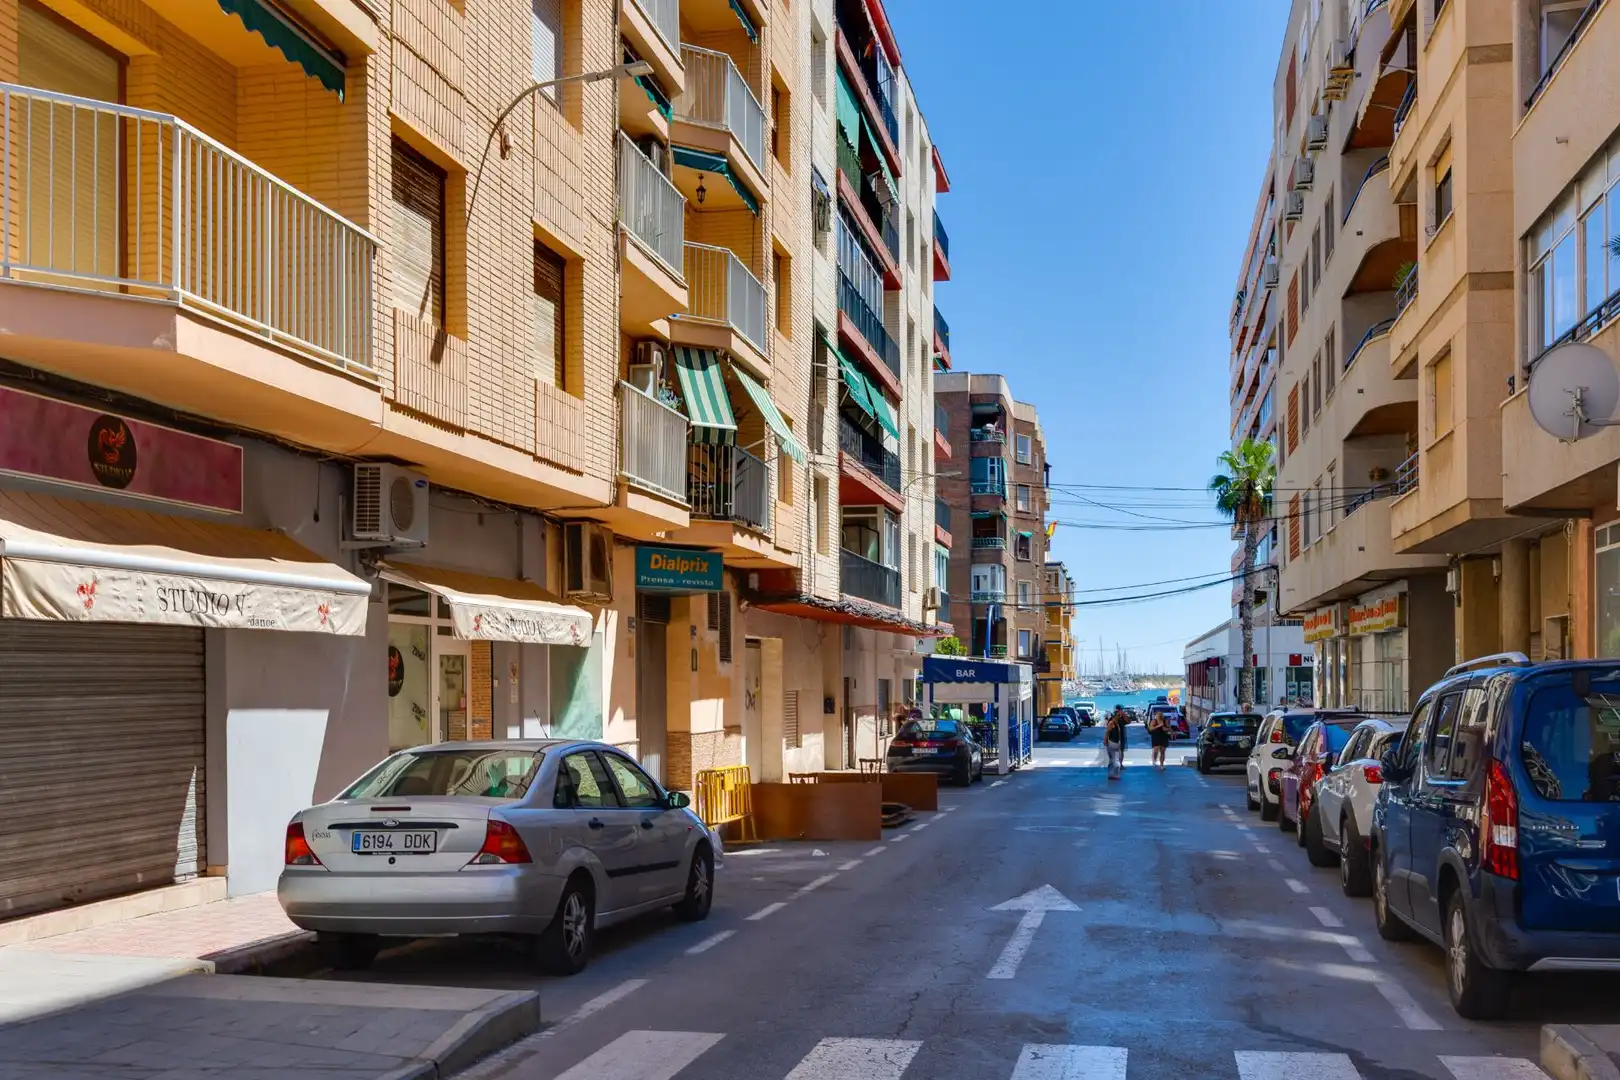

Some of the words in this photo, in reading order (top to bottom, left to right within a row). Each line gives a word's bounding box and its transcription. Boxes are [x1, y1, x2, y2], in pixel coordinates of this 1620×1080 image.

[650, 553, 709, 575] Dialprix
[640, 575, 674, 584] Prensa
[682, 578, 714, 587] revista
[156, 586, 230, 616] STUDIO
[235, 594, 246, 616] V
[955, 669, 976, 678] BAR
[362, 834, 393, 849] 6194
[404, 834, 431, 848] DDK
